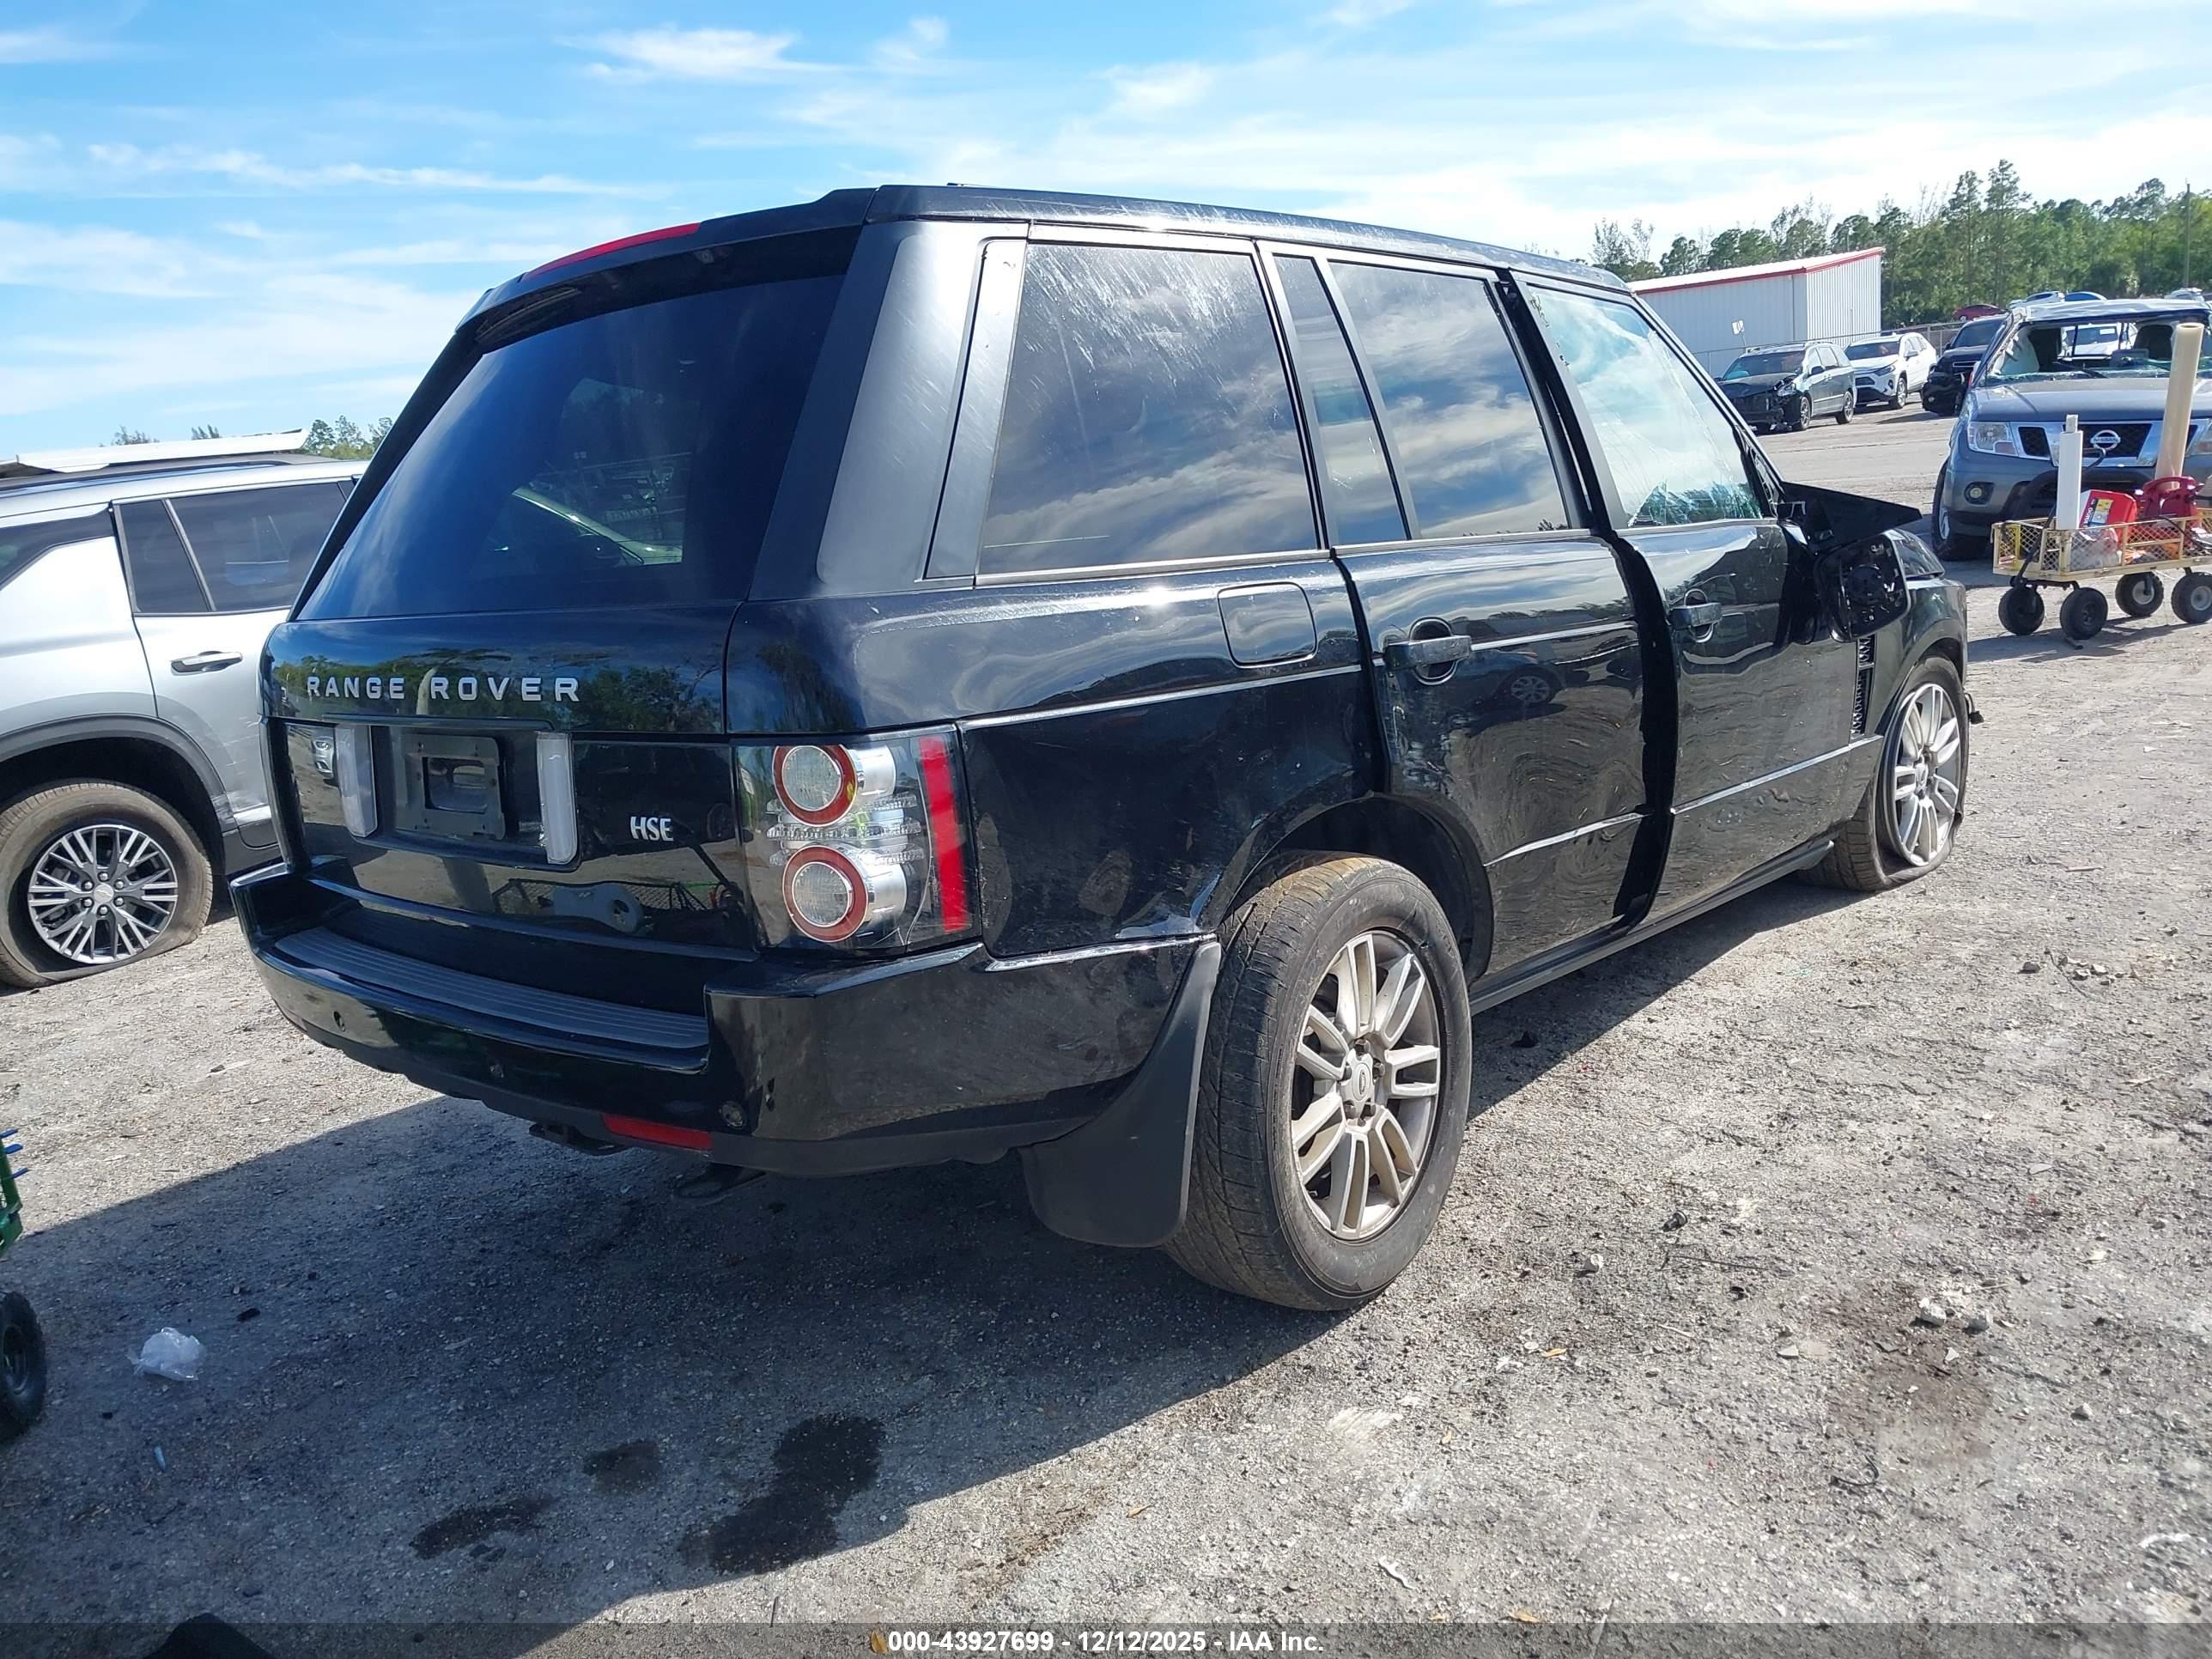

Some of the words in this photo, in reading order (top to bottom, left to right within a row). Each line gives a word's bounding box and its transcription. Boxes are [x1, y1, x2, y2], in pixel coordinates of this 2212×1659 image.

[307, 676, 405, 700] RANGE
[430, 677, 580, 702] ROVER
[630, 816, 674, 842] HSE
